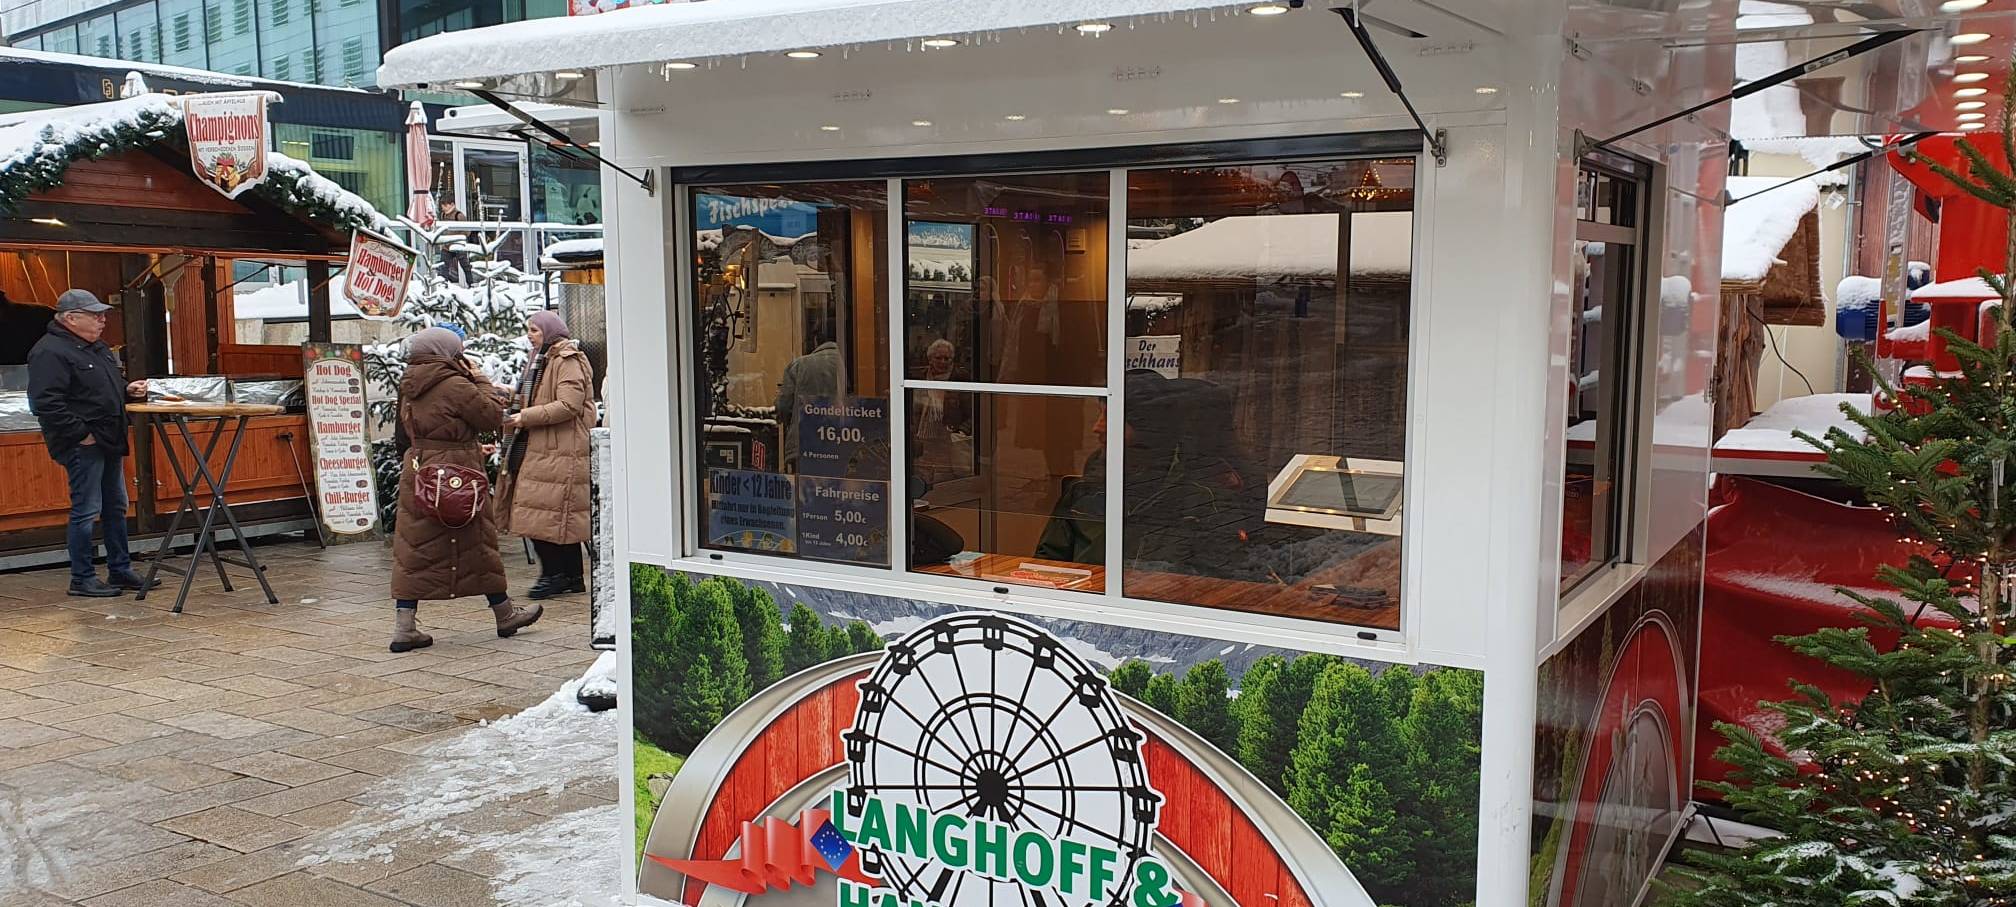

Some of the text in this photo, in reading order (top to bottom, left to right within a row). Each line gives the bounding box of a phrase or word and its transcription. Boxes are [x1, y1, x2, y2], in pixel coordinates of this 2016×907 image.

[190, 111, 260, 145] Champignons
[357, 248, 404, 282] Hamburger
[367, 268, 376, 277] &
[354, 270, 396, 303] Hot Dogs
[1139, 340, 1156, 352] Der
[316, 364, 352, 378] Hot Dog
[312, 395, 323, 405] Hot
[325, 395, 338, 406] Dog
[804, 403, 882, 418] Gondelticket
[317, 421, 361, 435] Hamburger
[809, 451, 839, 460] Personen
[320, 457, 368, 470] Cheeseburger
[710, 470, 740, 496] Kinder
[752, 474, 762, 497] 12
[764, 475, 792, 500] Jahre
[325, 491, 369, 504] Chili-Burger
[815, 486, 880, 501] Fahrpreise
[833, 789, 1183, 907] LANGHOFF &
